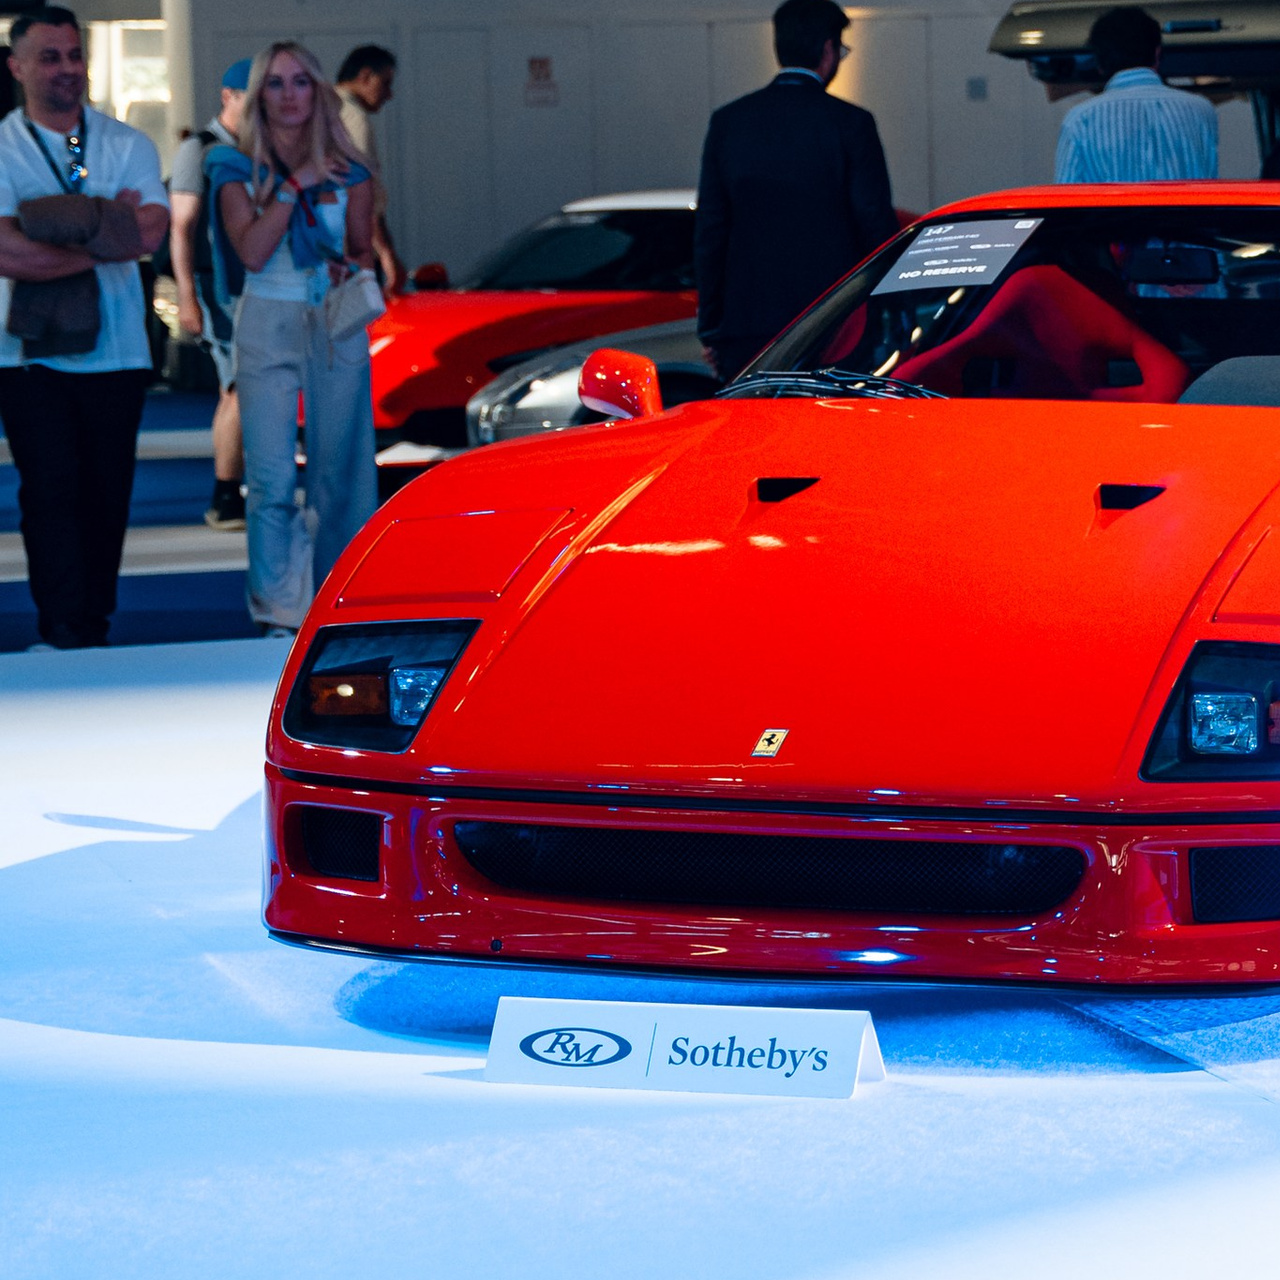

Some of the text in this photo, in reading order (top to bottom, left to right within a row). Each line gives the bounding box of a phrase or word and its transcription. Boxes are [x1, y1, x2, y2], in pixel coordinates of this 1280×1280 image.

[924, 225, 954, 236] 147
[899, 265, 987, 279] NO RESERVE
[543, 1031, 829, 1078] RM Sotheby's
